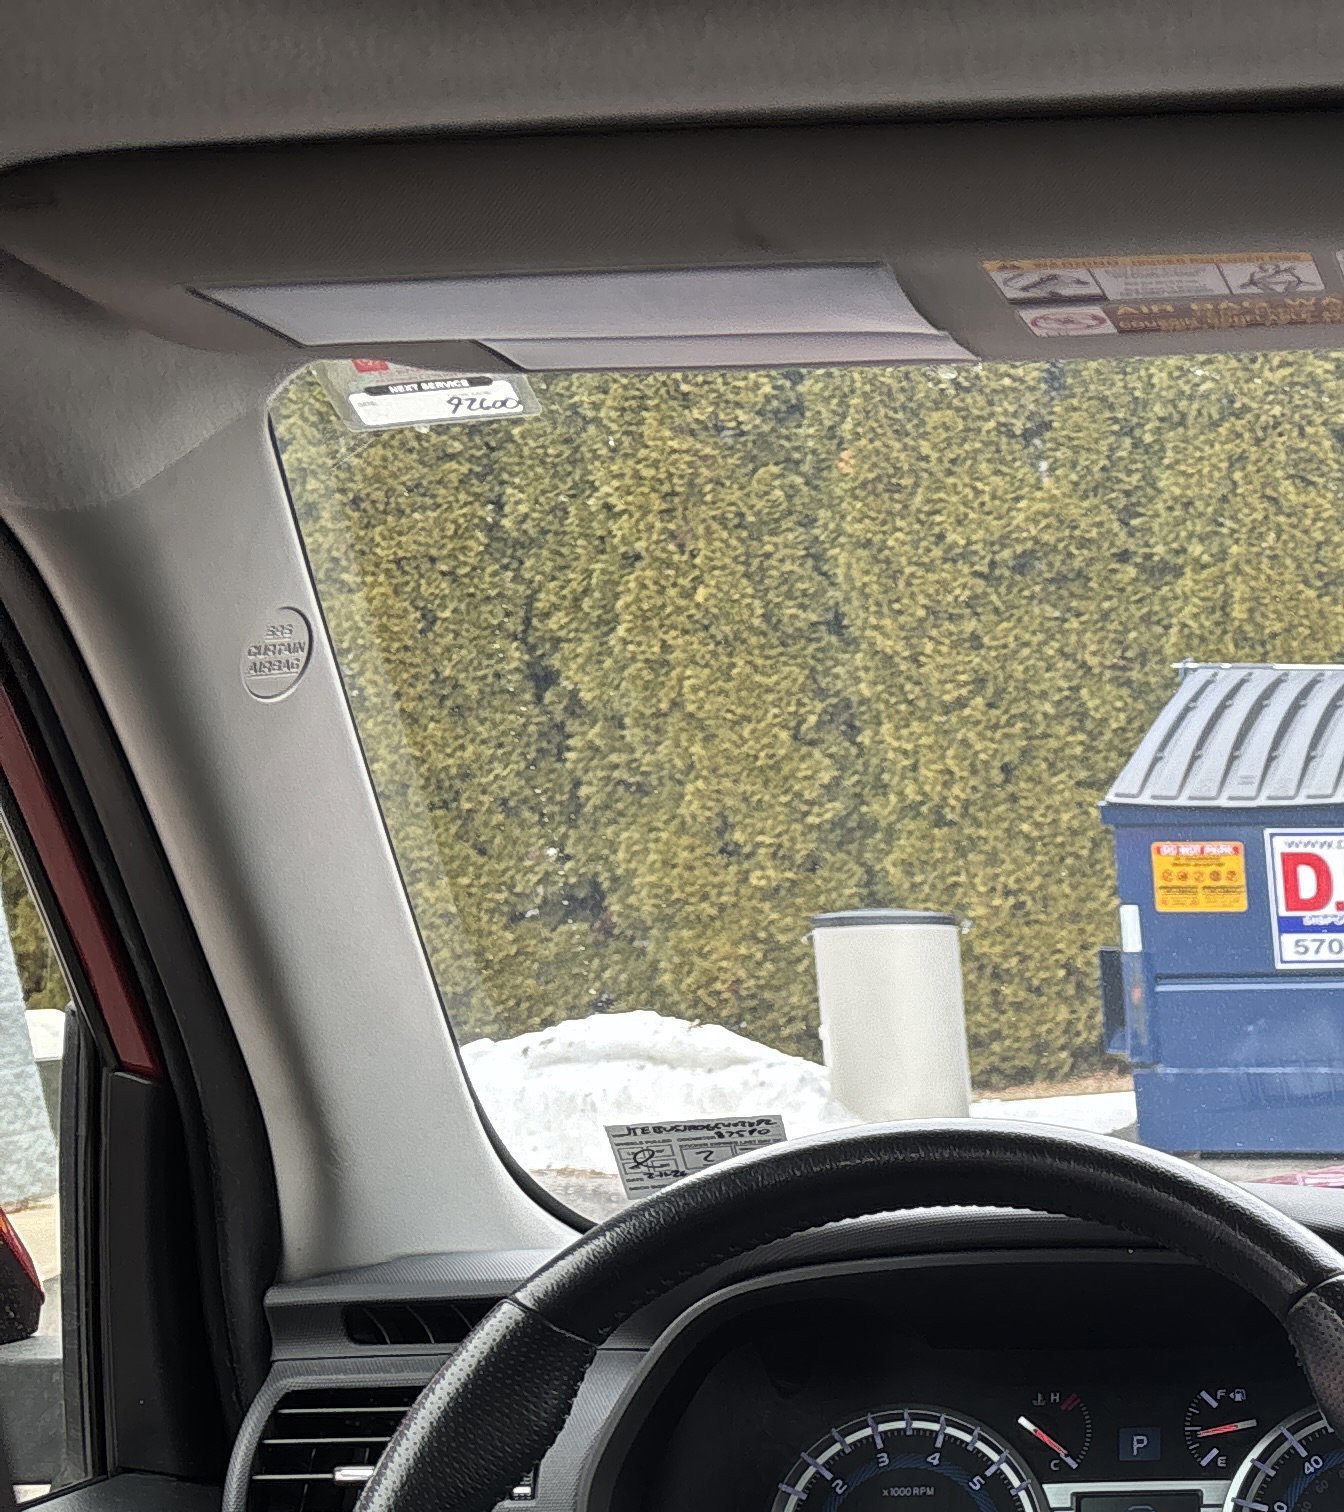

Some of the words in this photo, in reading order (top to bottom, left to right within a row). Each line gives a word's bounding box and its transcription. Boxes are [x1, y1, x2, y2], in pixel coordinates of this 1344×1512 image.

[388, 383, 419, 394] NEXT
[422, 379, 470, 391] SERVICE
[1050, 1392, 1060, 1404] H
[1216, 1388, 1226, 1401] F
[1131, 1434, 1148, 1455] P
[875, 1451, 890, 1467] 3
[925, 1451, 940, 1466] 4
[1049, 1459, 1060, 1471] C
[1217, 1455, 1228, 1468] E
[1304, 1455, 1323, 1475] 40
[831, 1478, 848, 1496] 2
[968, 1476, 986, 1492] 5
